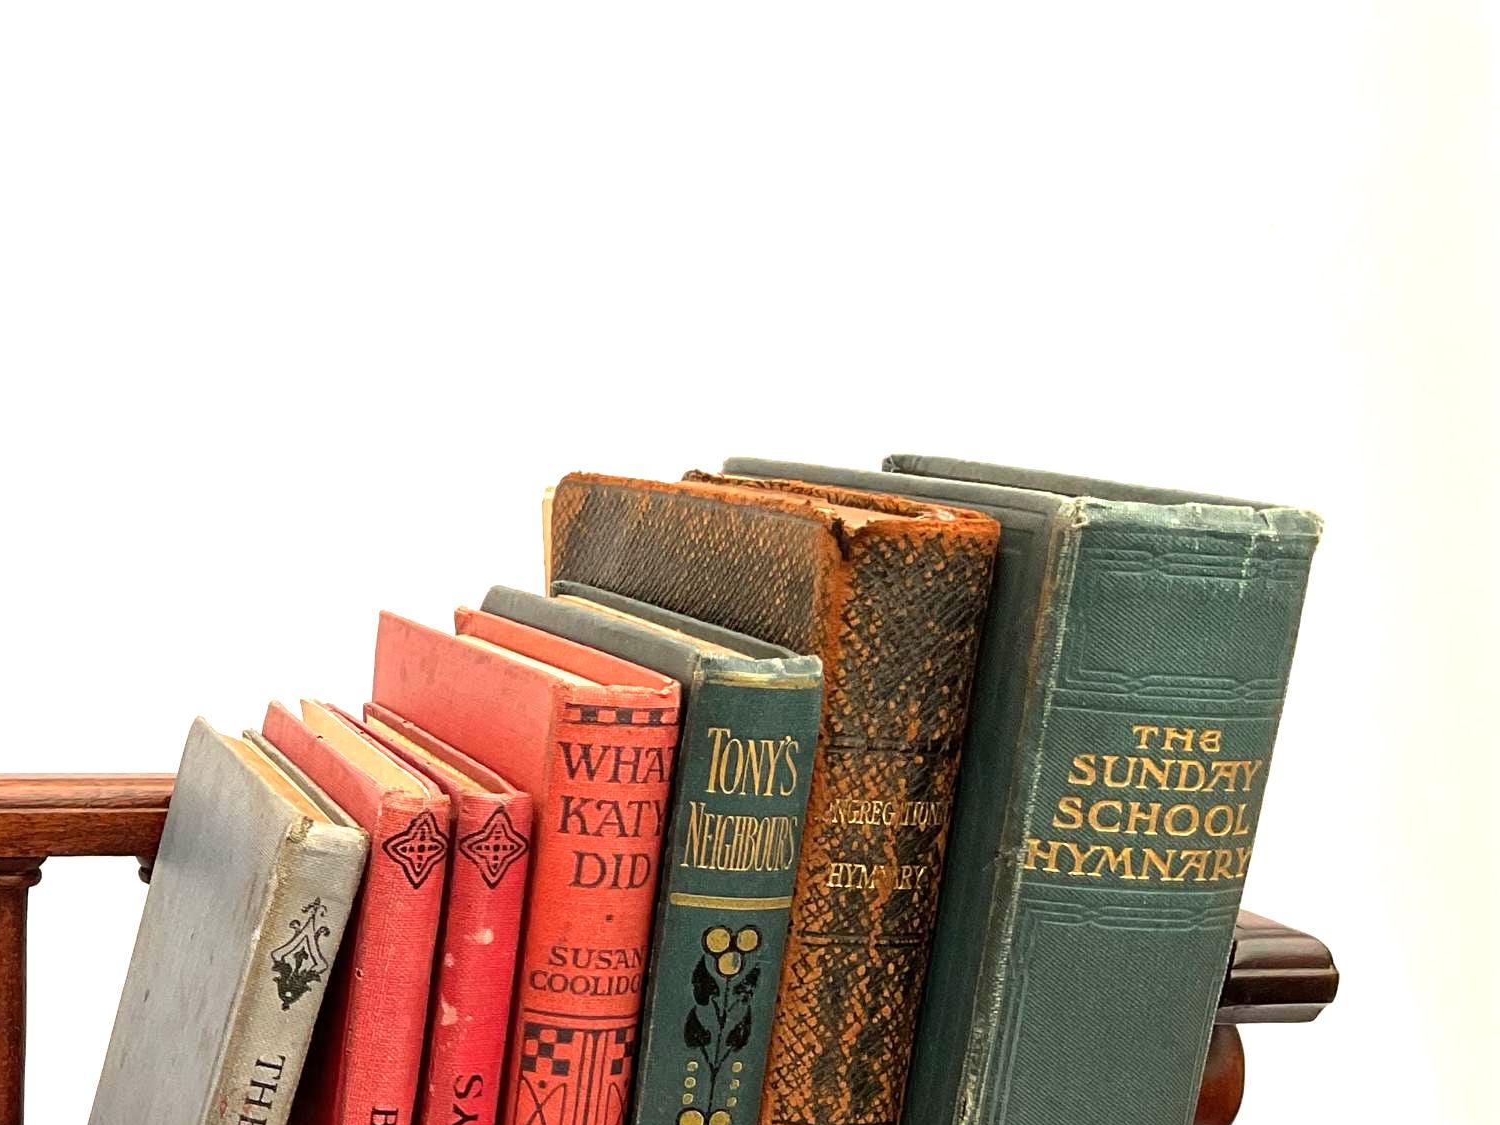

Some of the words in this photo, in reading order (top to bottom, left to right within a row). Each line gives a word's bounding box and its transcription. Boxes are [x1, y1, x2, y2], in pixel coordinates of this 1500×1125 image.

[1132, 724, 1222, 753] THE
[706, 727, 801, 797] TONY'S
[1067, 754, 1263, 792] SUNDAY
[680, 800, 799, 872] NEIGHBOURS
[1052, 797, 1250, 837] SCHOOL
[568, 850, 651, 890] DID
[1023, 837, 1251, 882] HYMNARY
[548, 944, 647, 970] SUSAN
